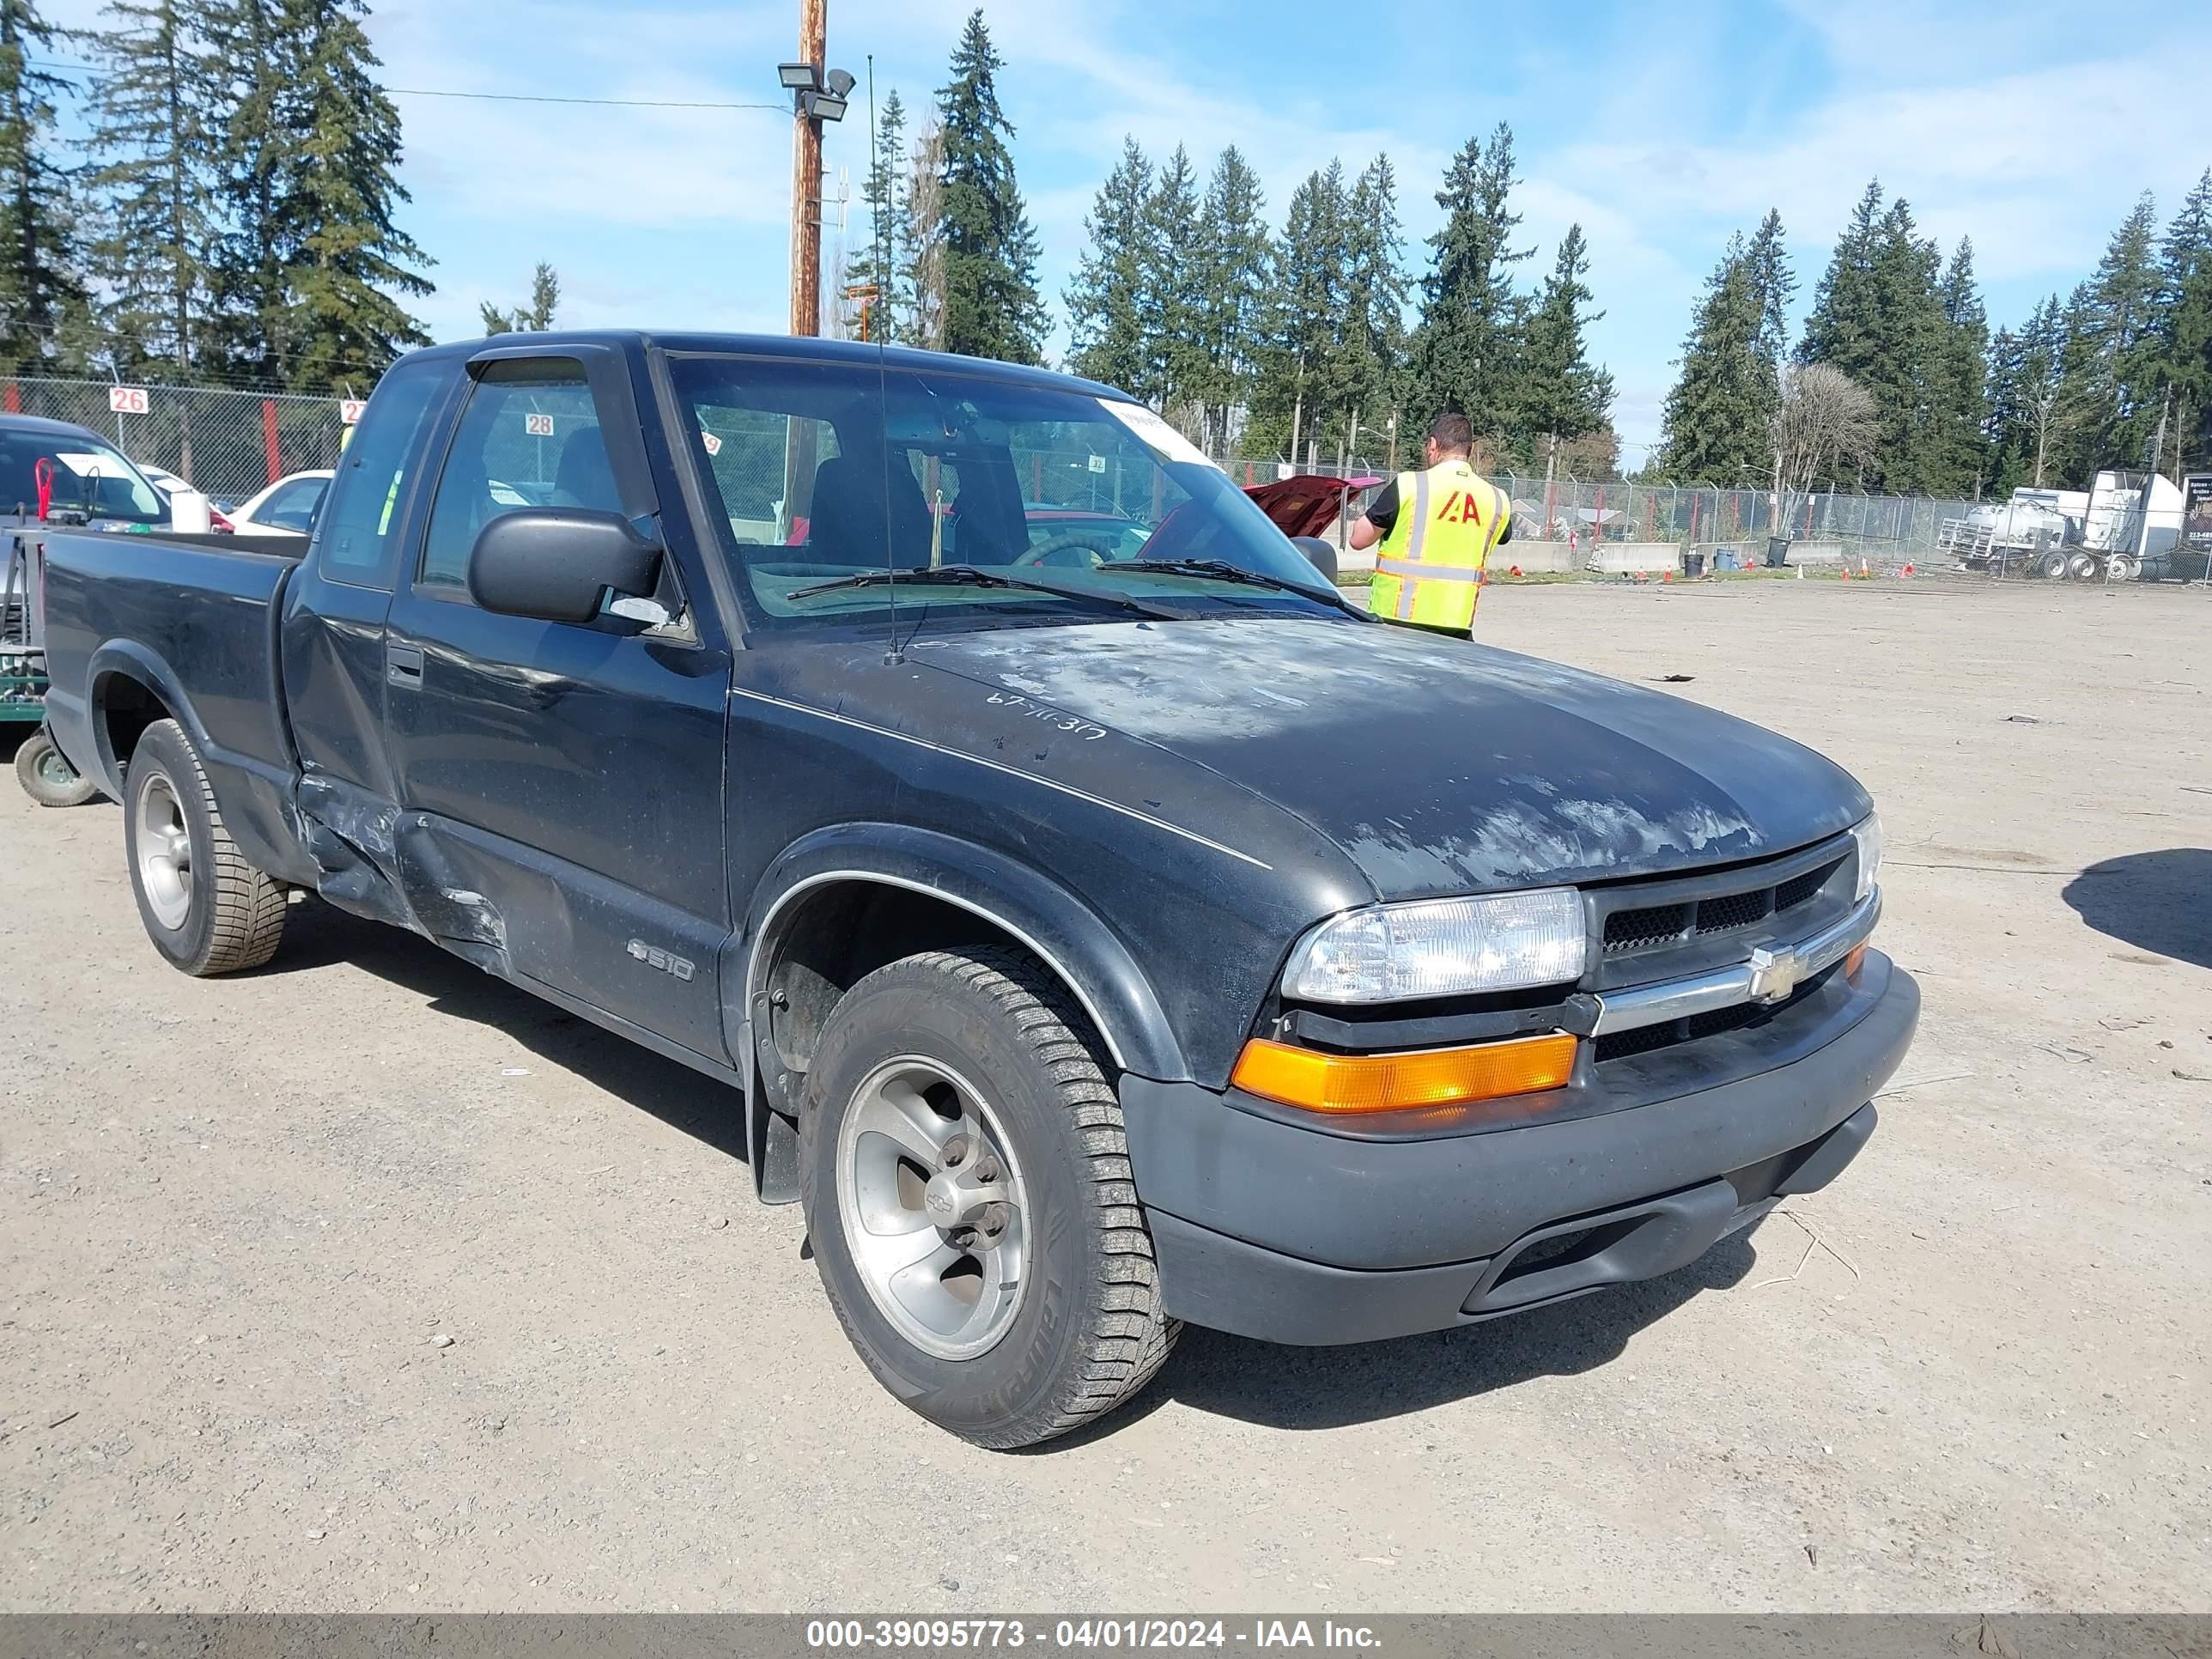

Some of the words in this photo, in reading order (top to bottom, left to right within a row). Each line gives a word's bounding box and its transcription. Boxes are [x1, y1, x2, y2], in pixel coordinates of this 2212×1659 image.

[114, 390, 143, 411] 26
[529, 416, 550, 434] 28
[648, 946, 695, 981] S10
